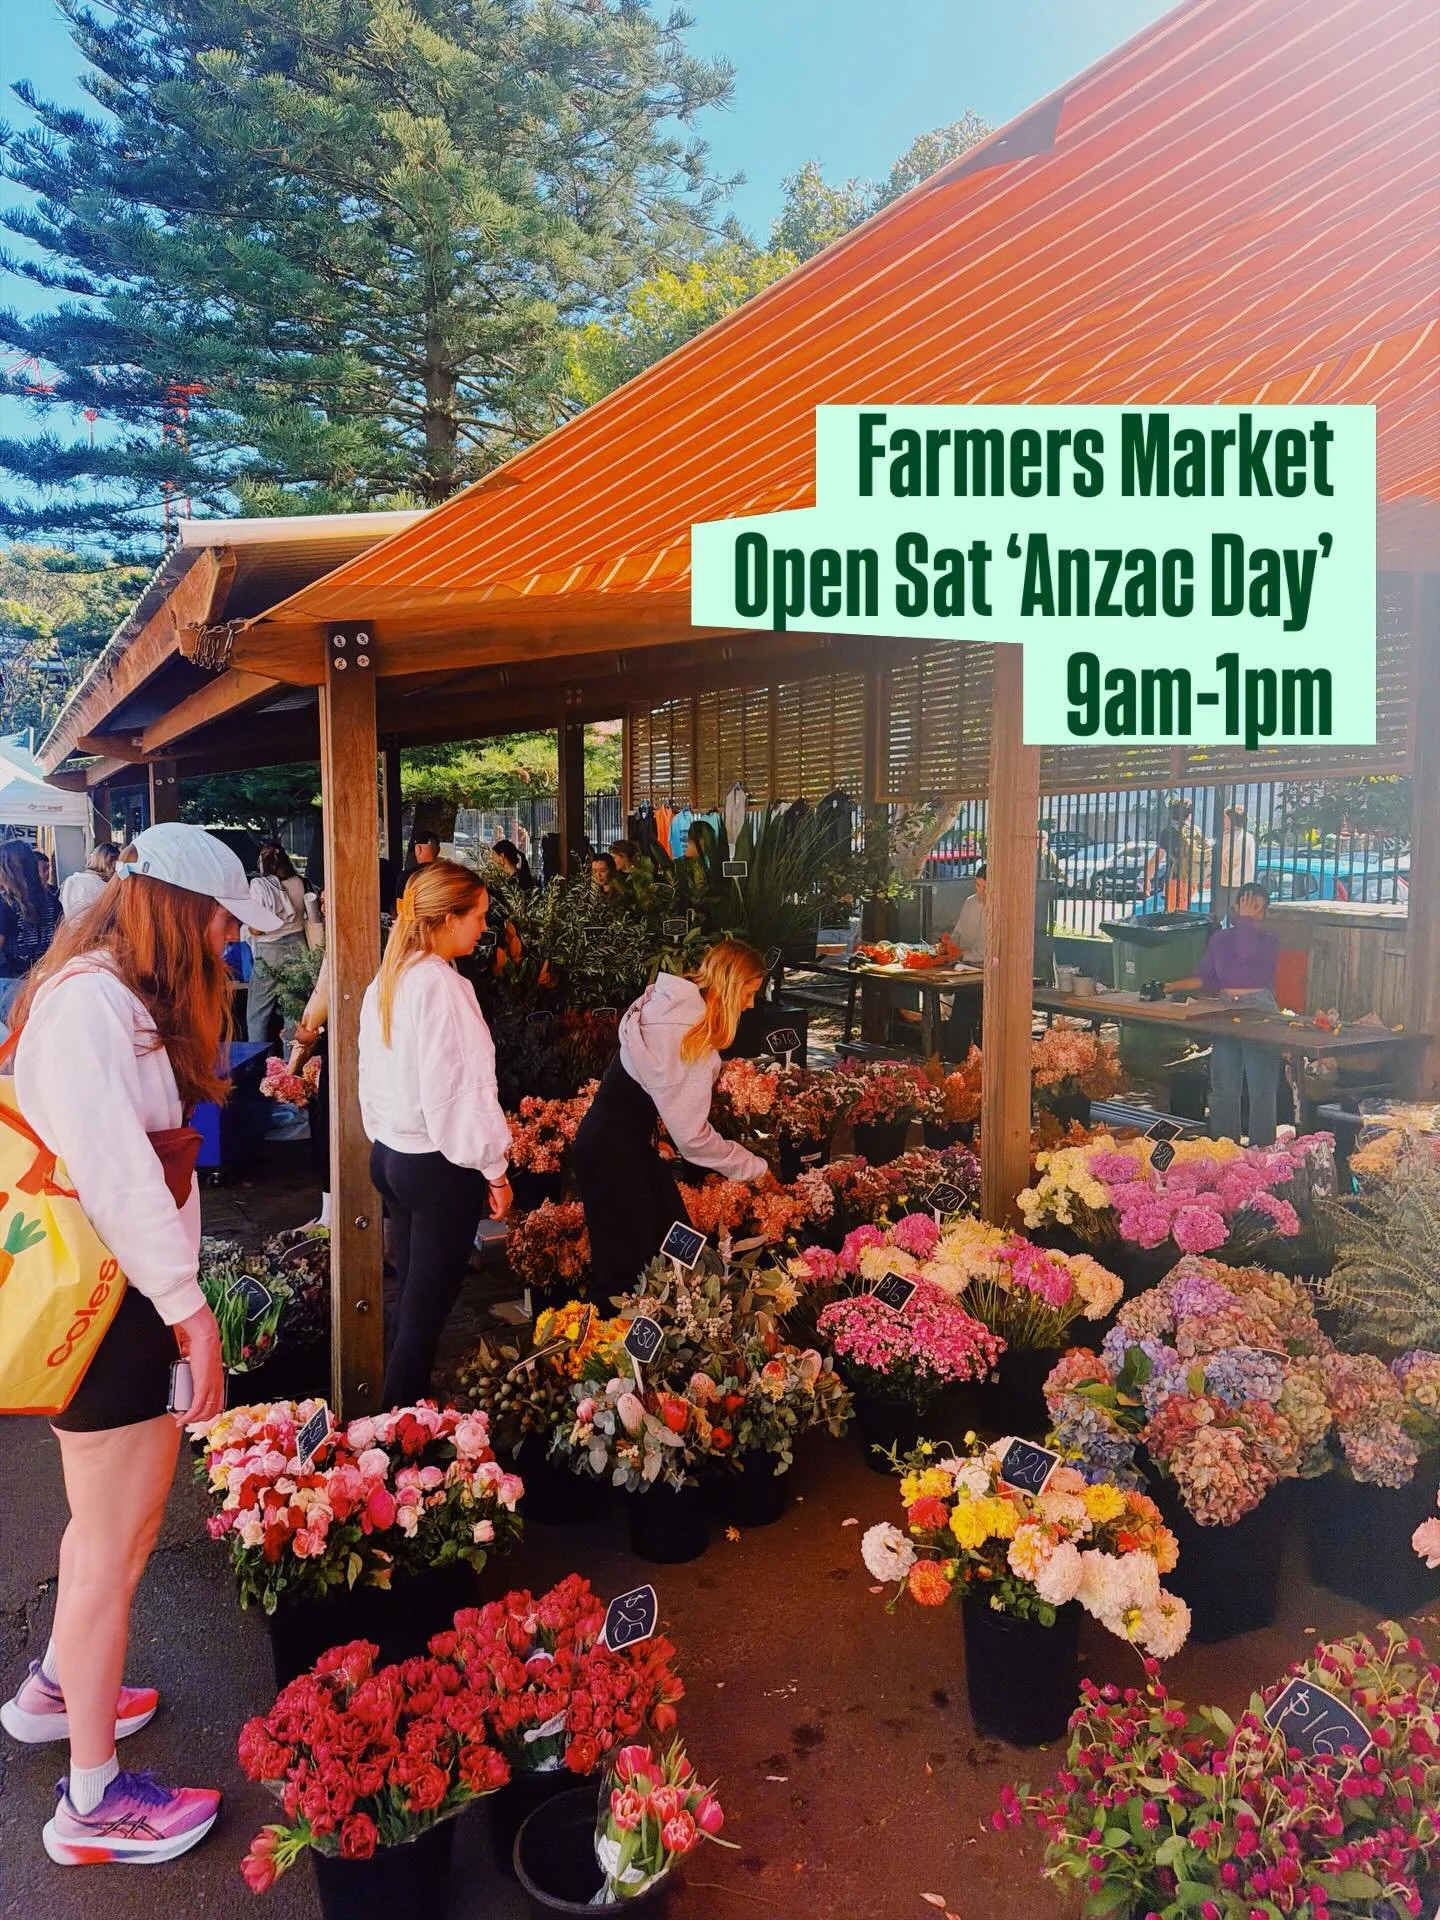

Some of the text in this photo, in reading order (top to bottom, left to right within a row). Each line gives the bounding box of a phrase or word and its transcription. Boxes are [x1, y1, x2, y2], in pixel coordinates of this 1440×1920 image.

[879, 1275, 908, 1302] $16
[47, 1258, 119, 1367] coles
[632, 1319, 656, 1349] $30
[1006, 1445, 1048, 1483] $20
[612, 1594, 648, 1643] $25
[1283, 1689, 1350, 1757] $16
